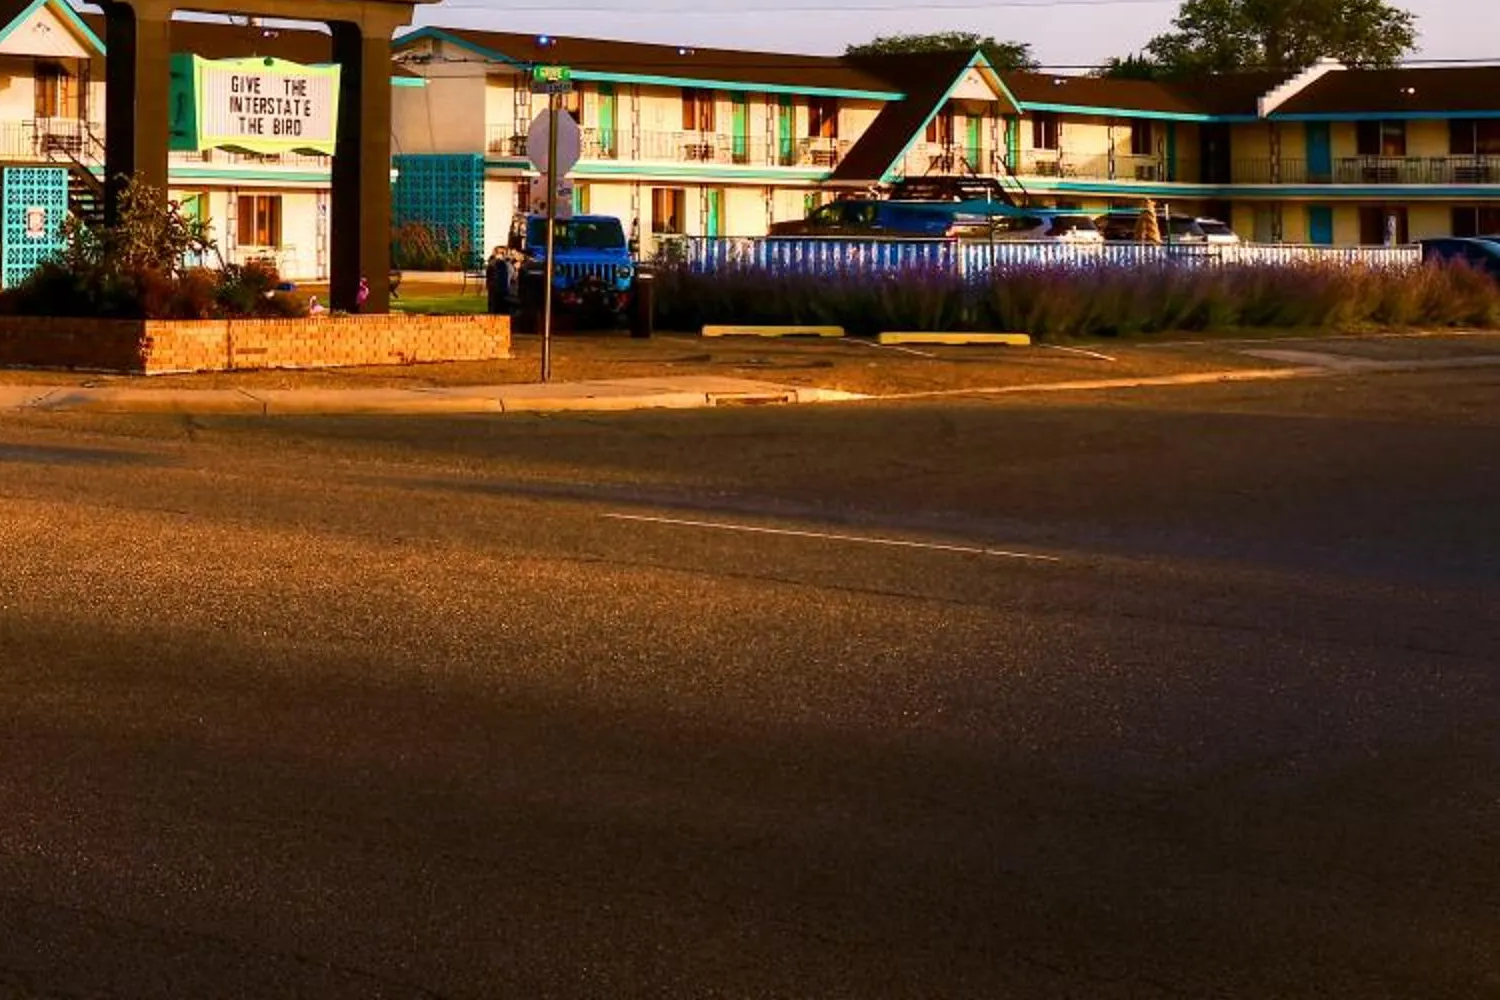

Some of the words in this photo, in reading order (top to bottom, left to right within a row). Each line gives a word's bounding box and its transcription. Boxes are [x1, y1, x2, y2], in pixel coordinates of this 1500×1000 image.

[231, 75, 261, 94] GIVE
[283, 79, 307, 97] THE
[229, 96, 311, 117] INTERSTATE
[238, 117, 264, 135] THE
[273, 119, 302, 136] BIRD
